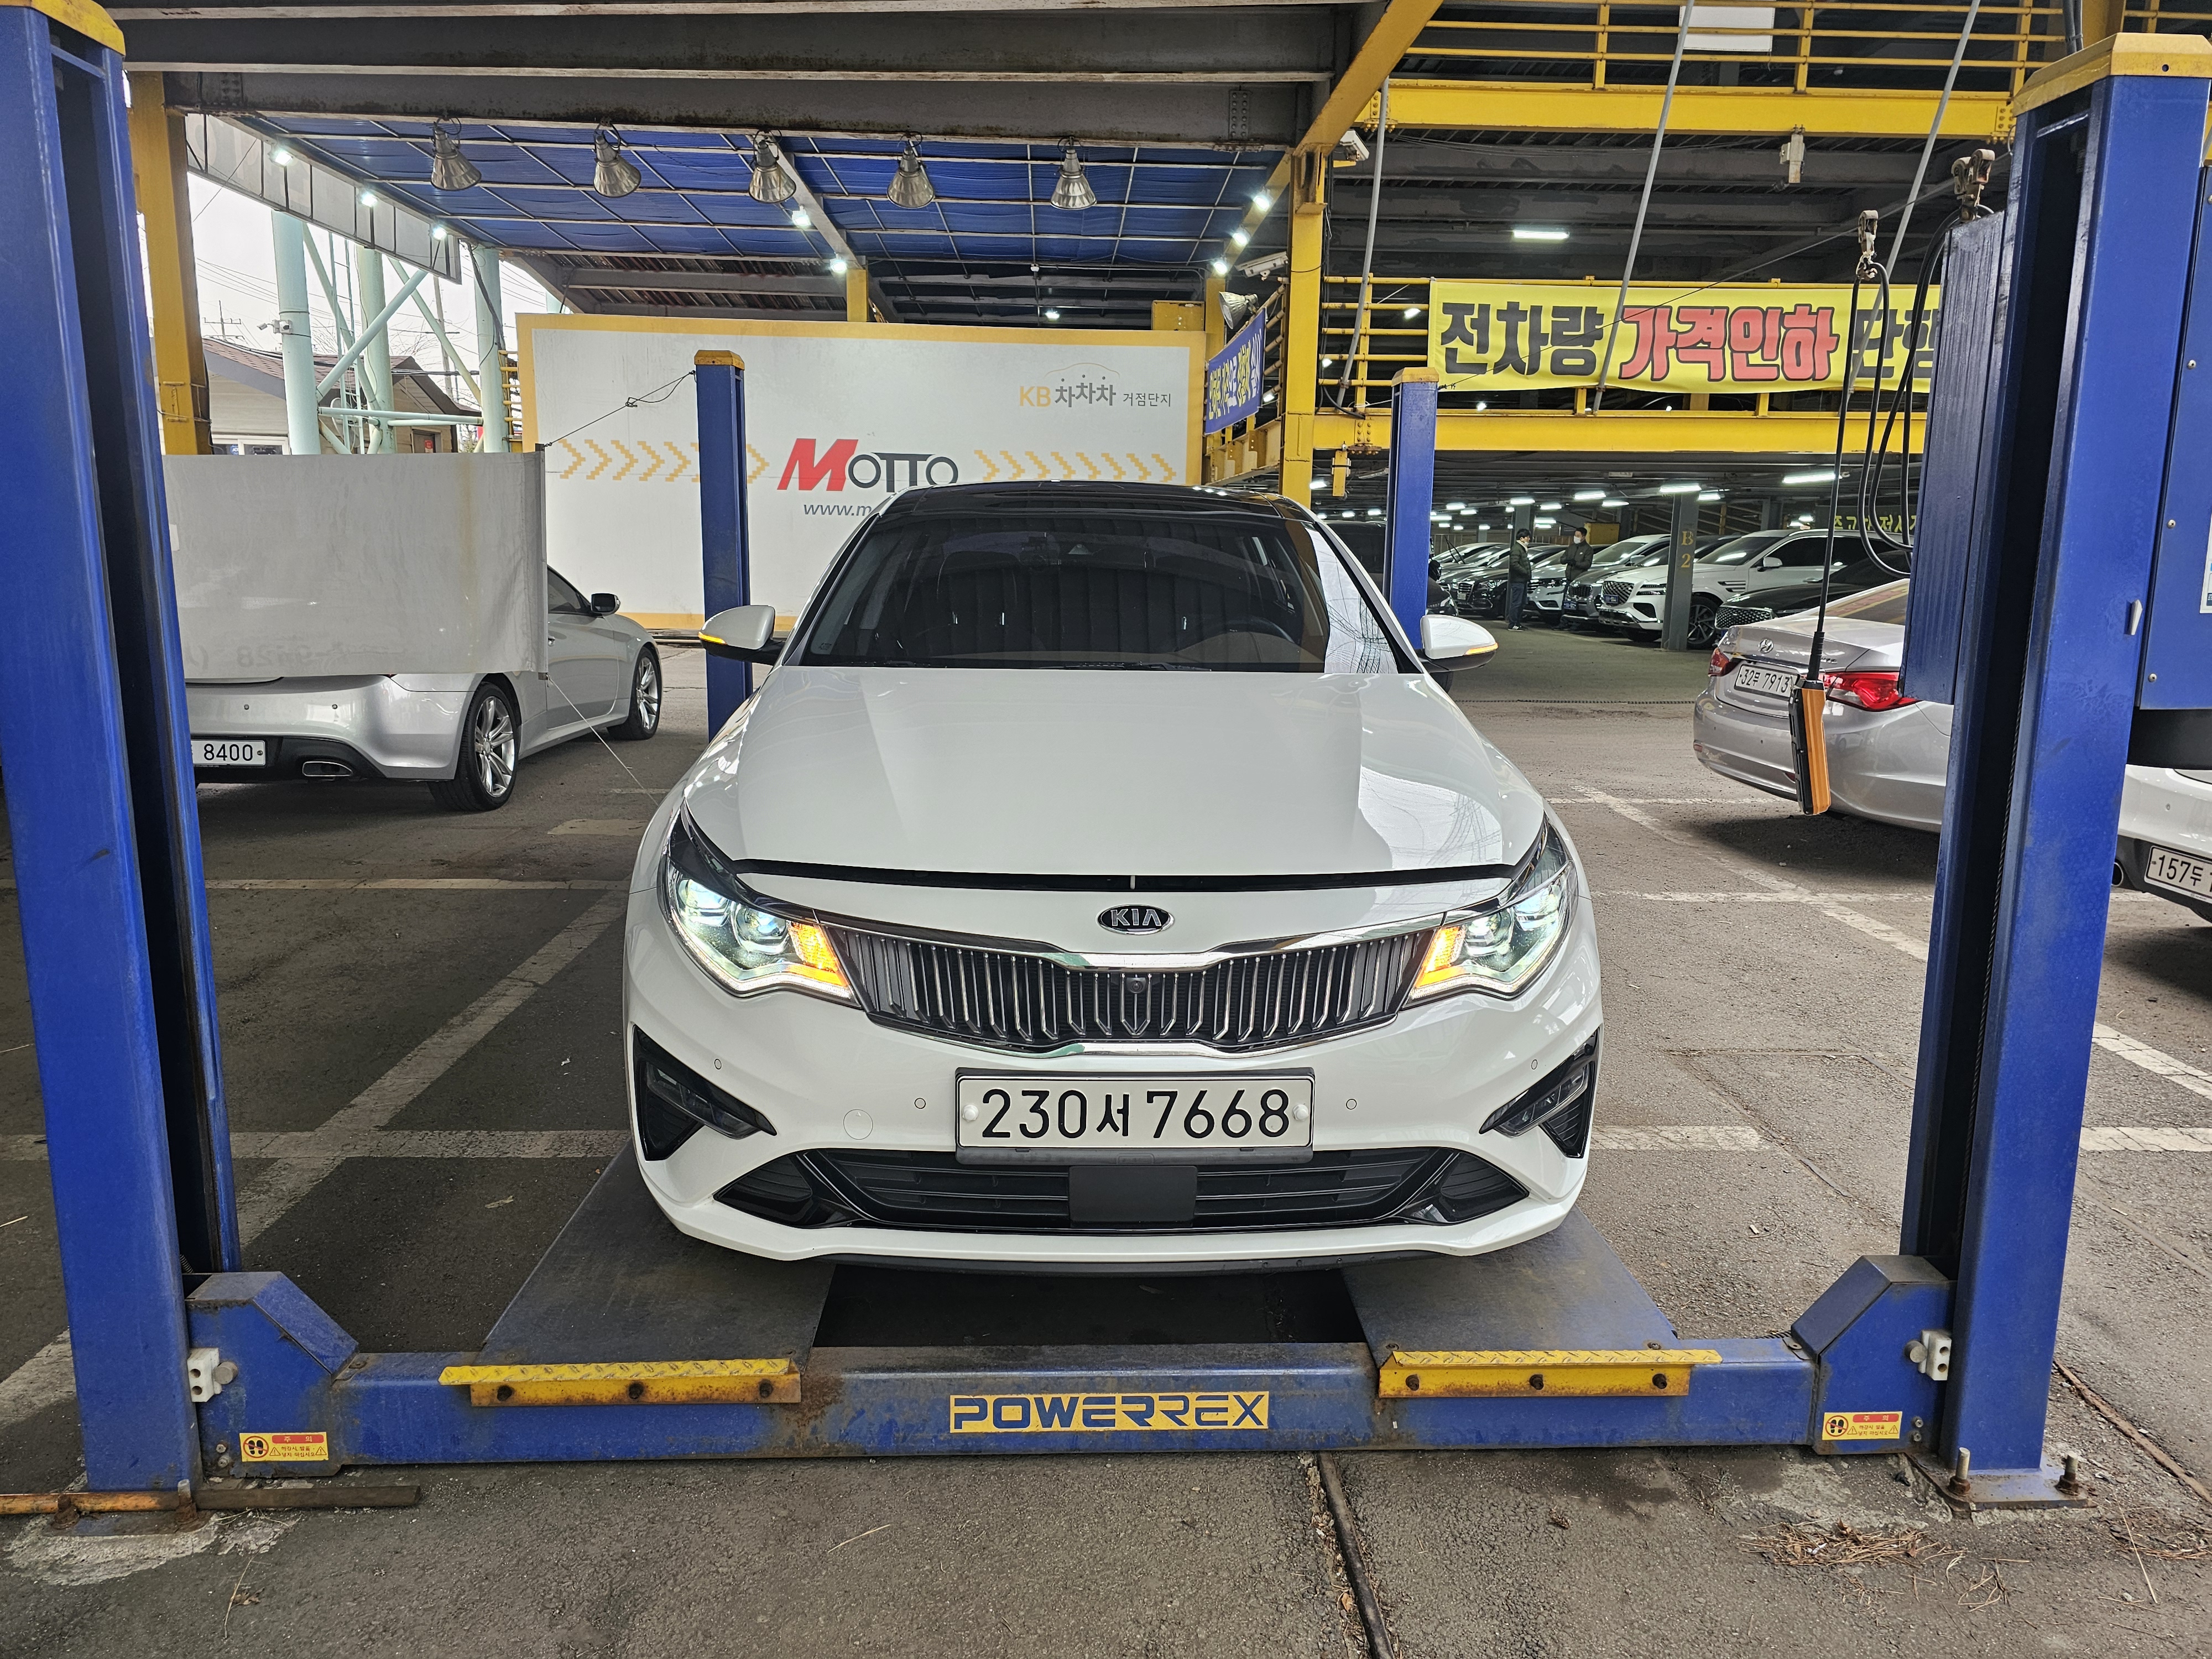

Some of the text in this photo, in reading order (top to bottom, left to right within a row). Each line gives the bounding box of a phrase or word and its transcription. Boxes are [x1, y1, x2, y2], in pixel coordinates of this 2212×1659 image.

[1439, 300, 1604, 377] 전차량
[1619, 304, 1840, 382] 가격인하
[1019, 374, 1172, 408] KB 차차차 거점단지
[1681, 531, 1693, 546] B
[1681, 554, 1691, 568] 2
[1110, 909, 1162, 926] KIA
[954, 1394, 1265, 1430] POWERREX
